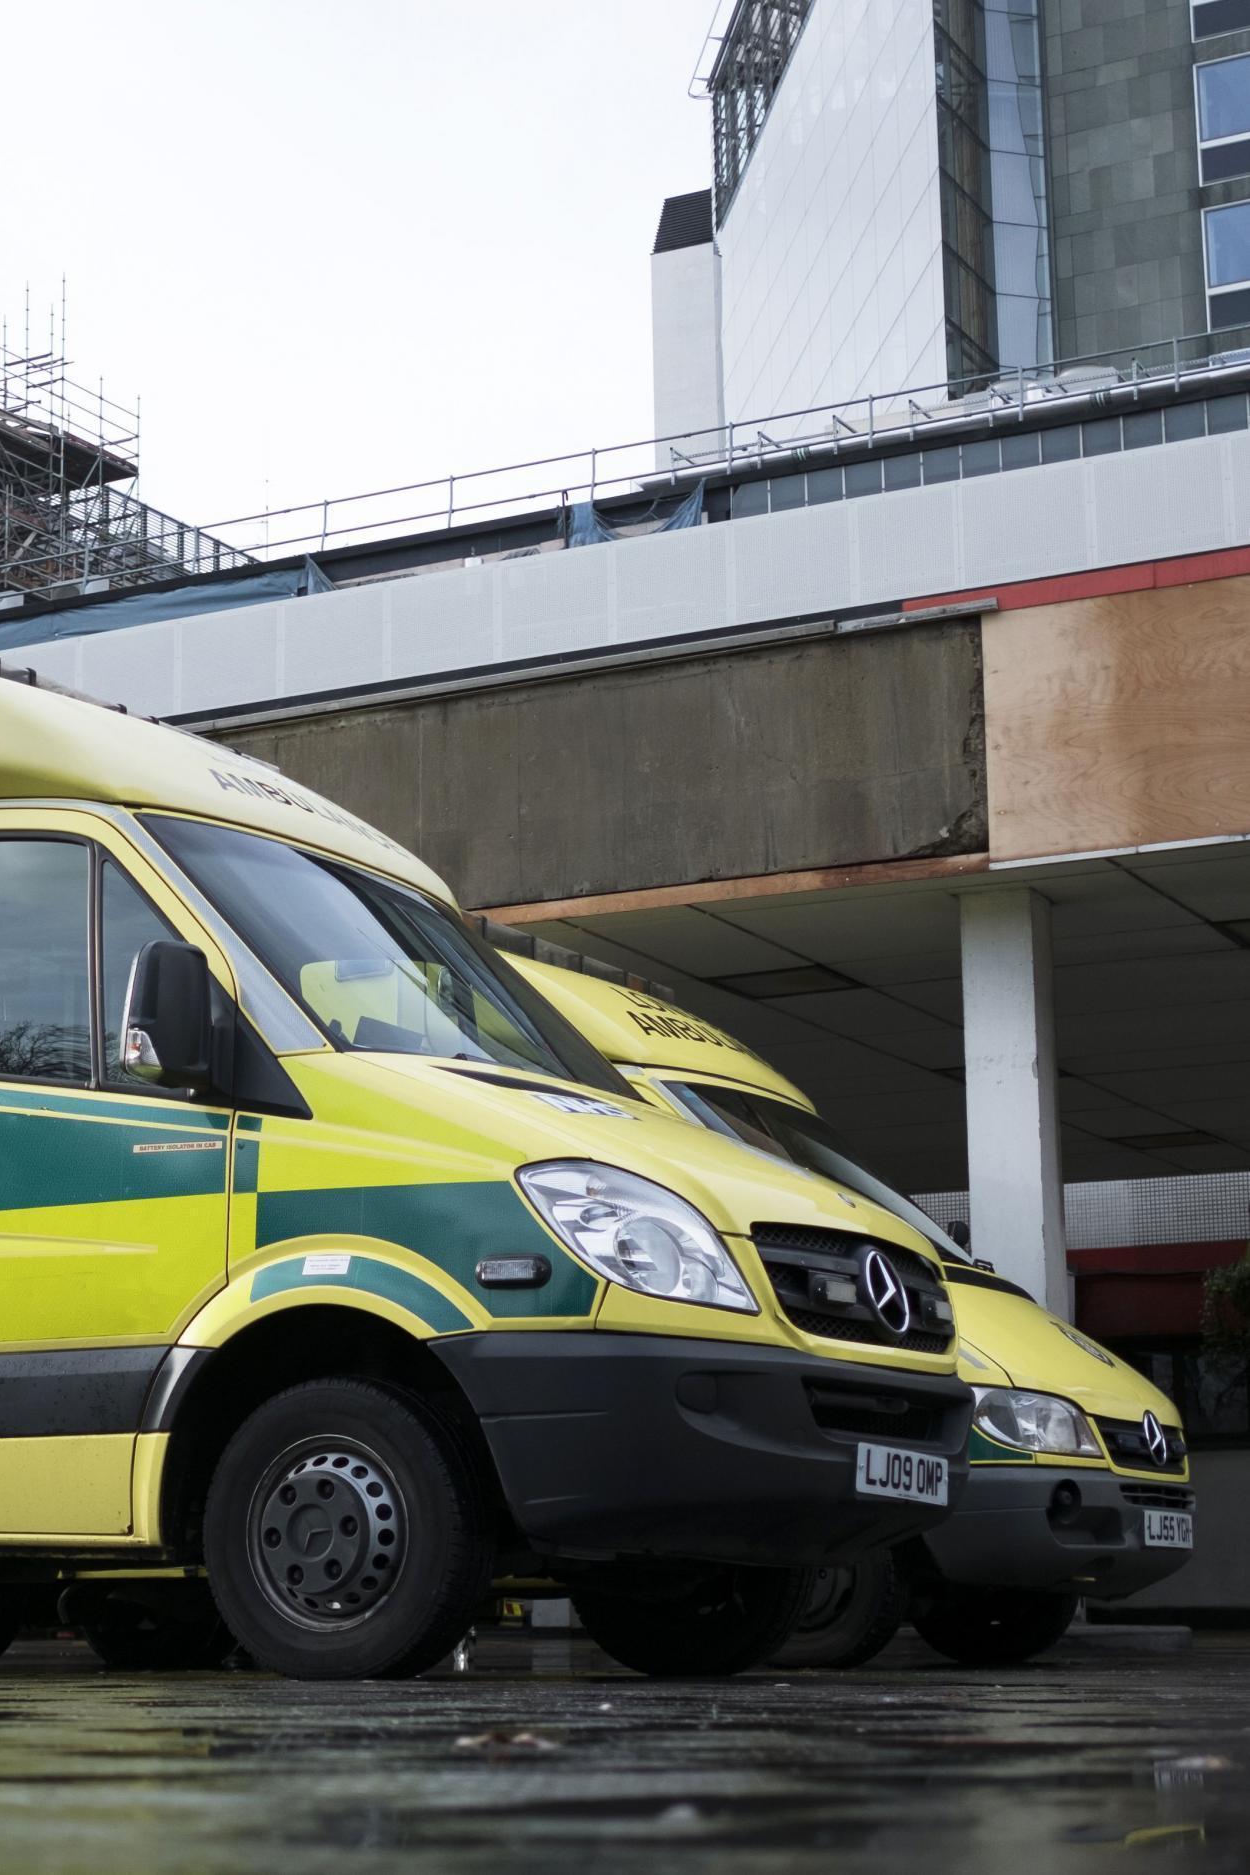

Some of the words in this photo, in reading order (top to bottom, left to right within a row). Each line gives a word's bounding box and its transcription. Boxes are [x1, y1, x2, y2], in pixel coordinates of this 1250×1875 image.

[626, 1010, 776, 1072] AMBUL
[535, 1093, 634, 1119] NHS
[865, 1449, 913, 1491] LJ09
[917, 1458, 943, 1495] OMP
[1148, 1513, 1175, 1541] LJ55
